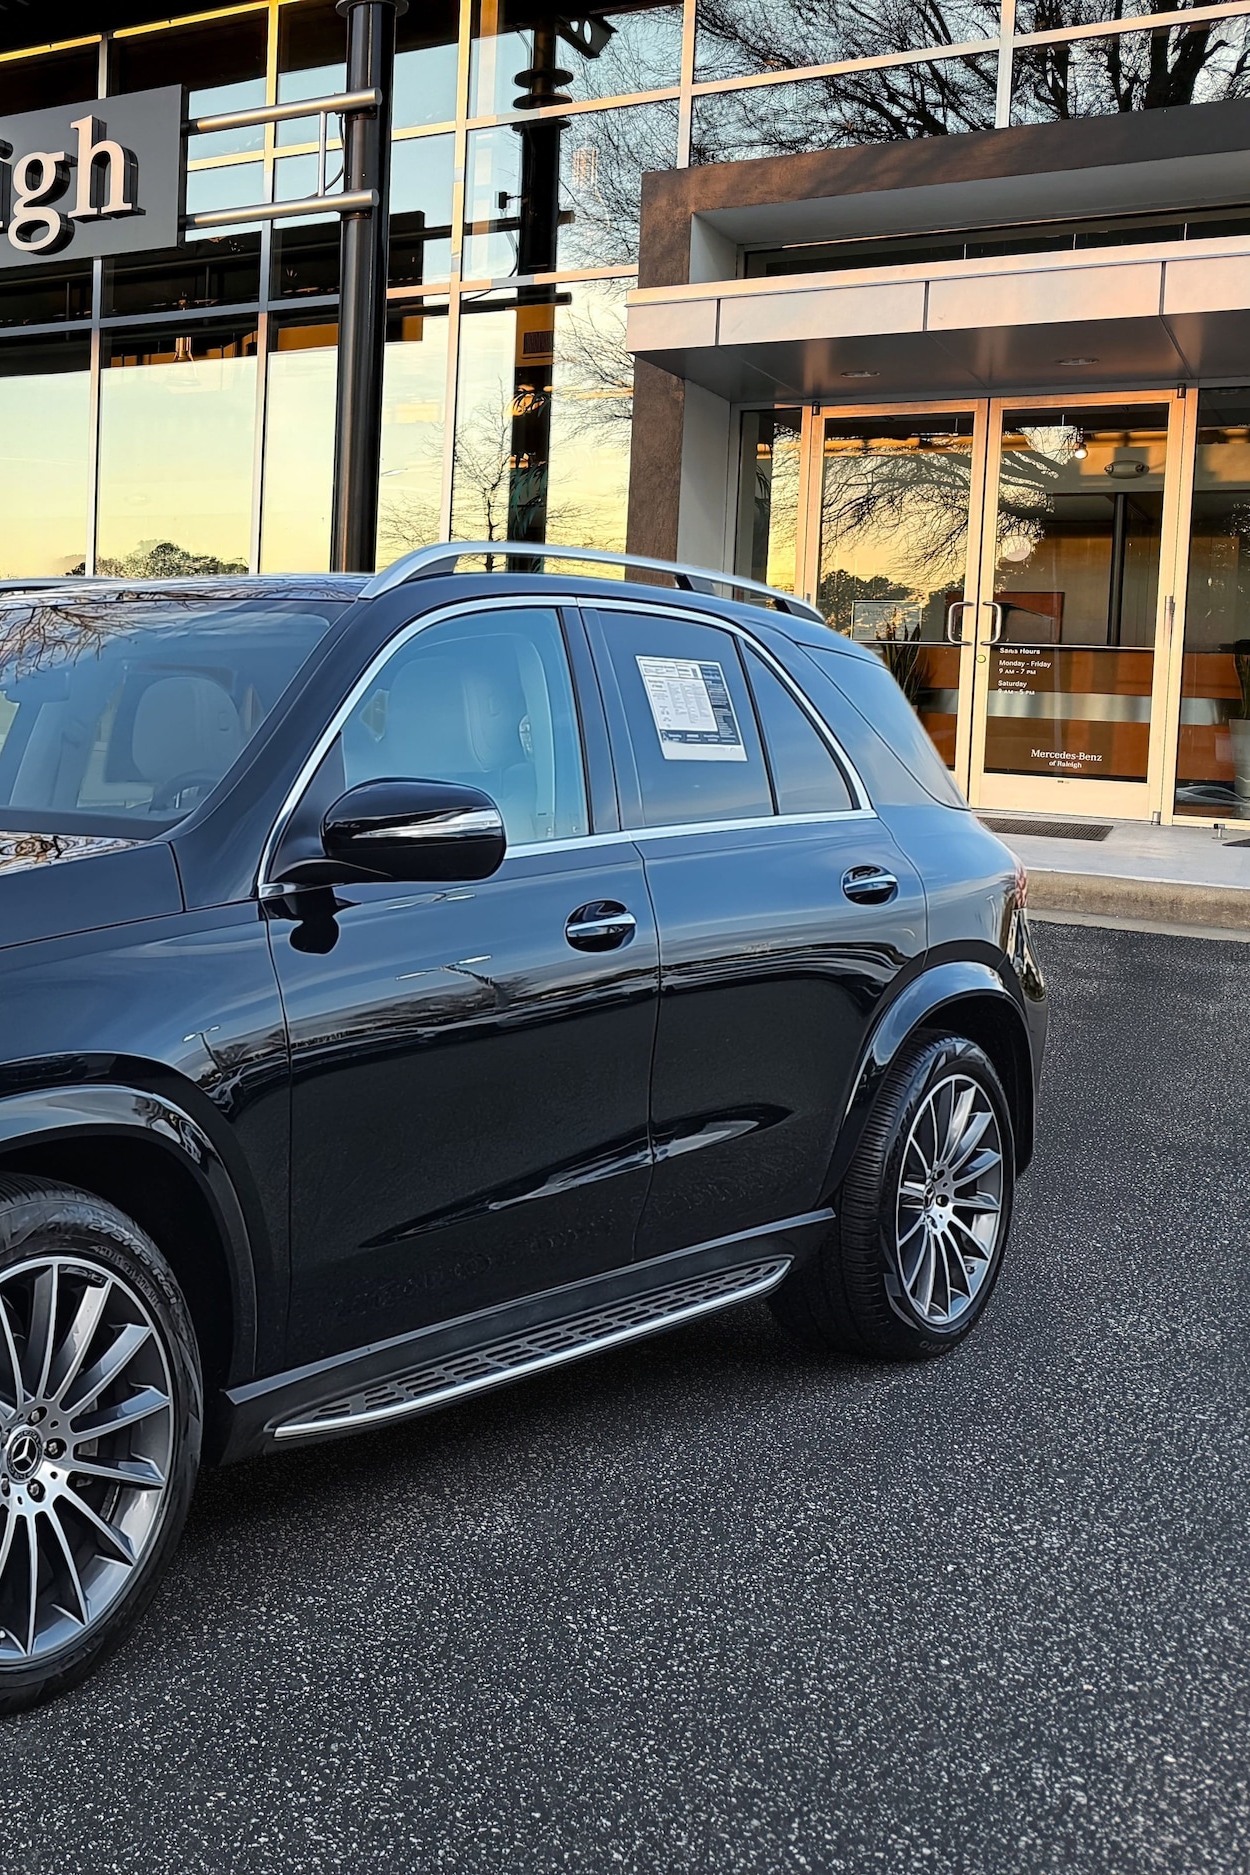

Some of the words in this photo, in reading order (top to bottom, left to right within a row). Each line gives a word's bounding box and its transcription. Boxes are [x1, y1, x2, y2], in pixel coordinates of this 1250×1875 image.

[998, 660, 1025, 668] Monday
[1030, 660, 1051, 668] Friday
[998, 680, 1027, 688] Saturday
[1030, 749, 1103, 762] Mercedes-Benz
[1057, 761, 1082, 769] Raleigh
